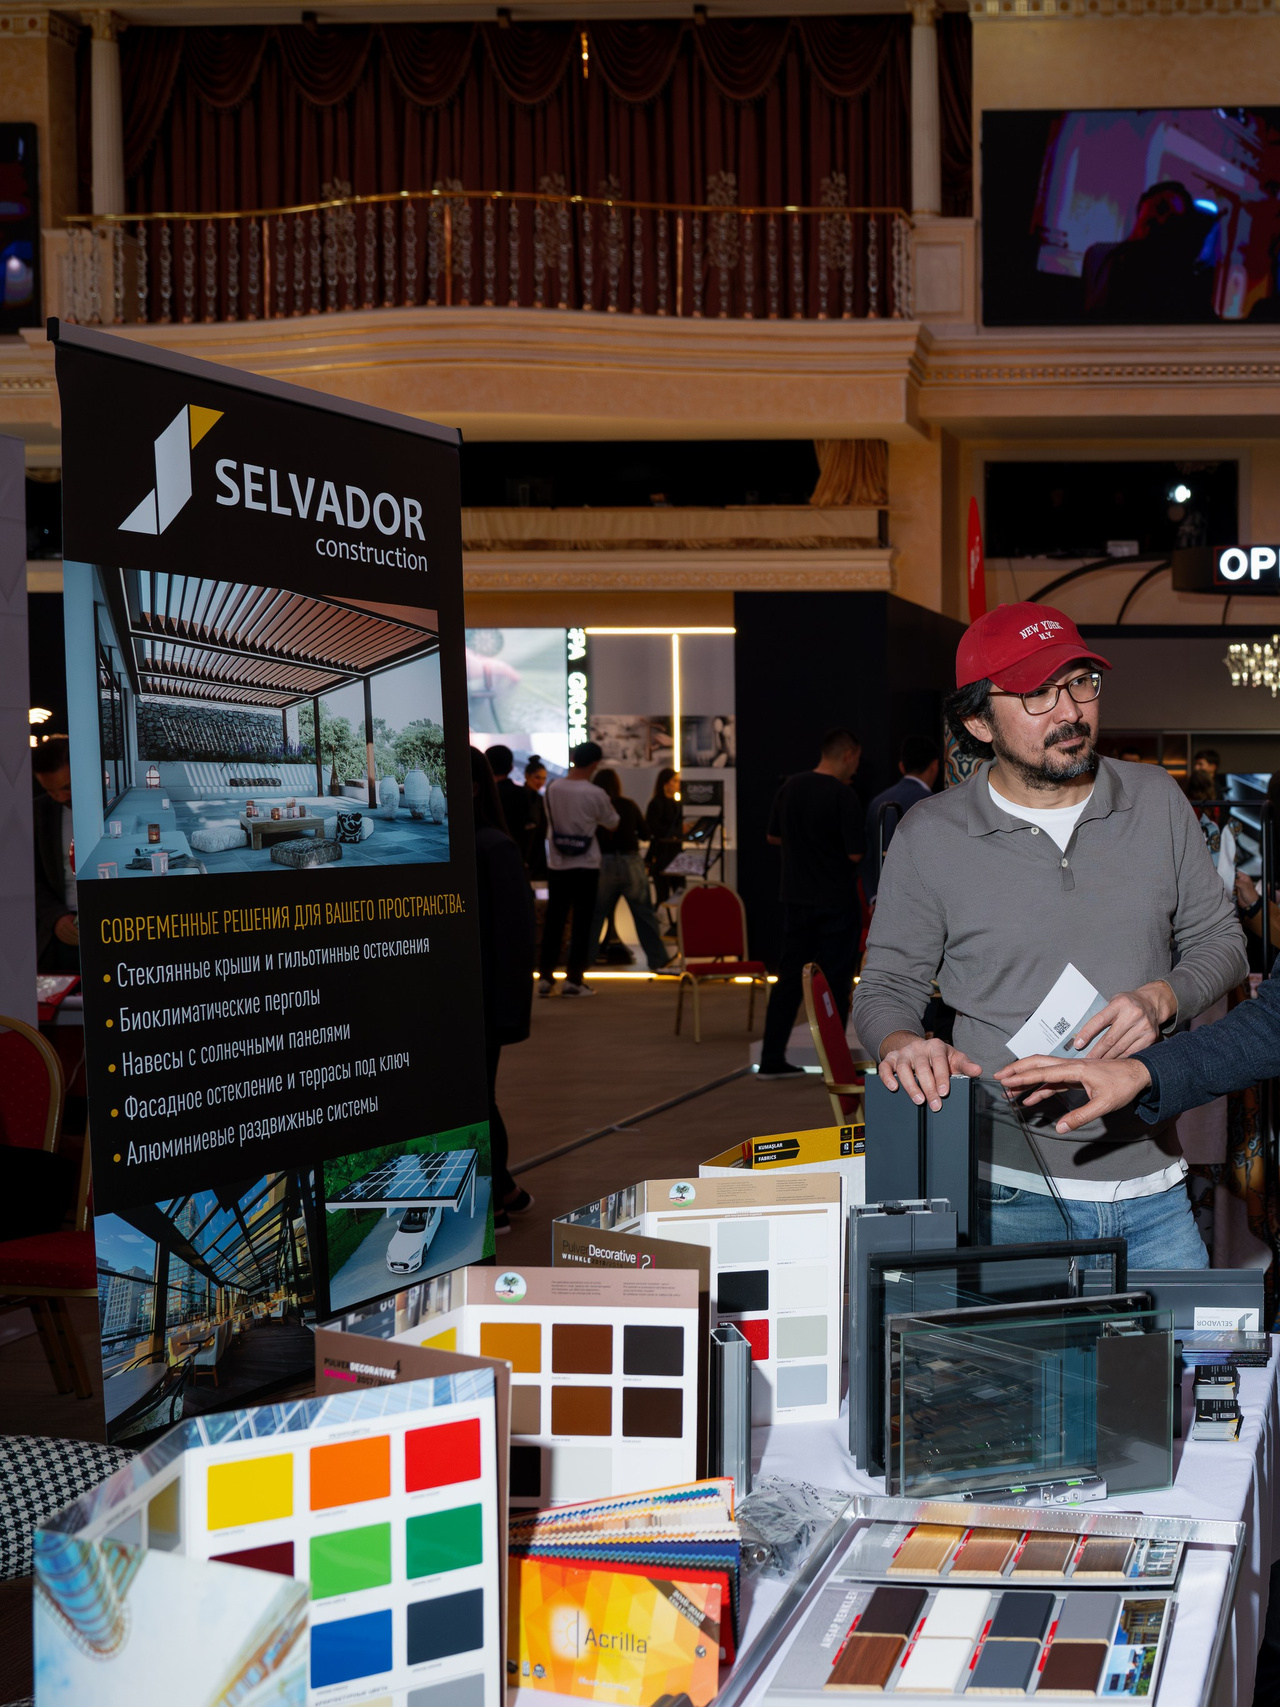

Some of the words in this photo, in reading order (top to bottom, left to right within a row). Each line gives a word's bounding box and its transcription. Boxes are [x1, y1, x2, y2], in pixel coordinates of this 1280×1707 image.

[215, 458, 426, 541] SELVADOR
[315, 538, 428, 572] construction
[1019, 623, 1039, 640] NEW
[1040, 619, 1064, 630] YORK
[567, 671, 588, 748] GROHE
[100, 911, 220, 944] СОВРЕМЕННЫЕ
[223, 905, 290, 933] РЕШЕНИЯ
[294, 903, 322, 931] ДЛЯ
[325, 899, 375, 925] ВАШЕГО
[378, 893, 466, 920] ПРОСТРАНСТВА:
[117, 960, 211, 988] Стеклянные
[214, 955, 261, 982] крыши
[265, 953, 274, 971] и
[278, 944, 360, 969] гильотинные
[363, 937, 430, 960] остекления
[119, 996, 261, 1032] Биоклиматические
[264, 988, 321, 1016] перголы
[122, 1050, 184, 1077] Навесы
[188, 1048, 197, 1066] с
[200, 1034, 284, 1064] солнечными
[288, 1023, 351, 1049] панелями
[124, 1090, 203, 1121] Фасадное
[206, 1075, 283, 1106] остекление
[287, 1072, 295, 1090] и
[299, 1062, 351, 1091] террасы
[355, 1057, 377, 1078] под
[379, 1051, 410, 1072] ключ
[126, 1126, 235, 1167] Алюминиевые
[239, 1107, 324, 1144] раздвижные
[327, 1095, 379, 1122] системы
[758, 1154, 777, 1162] FABRICS
[585, 1628, 648, 1654] Acrilla
